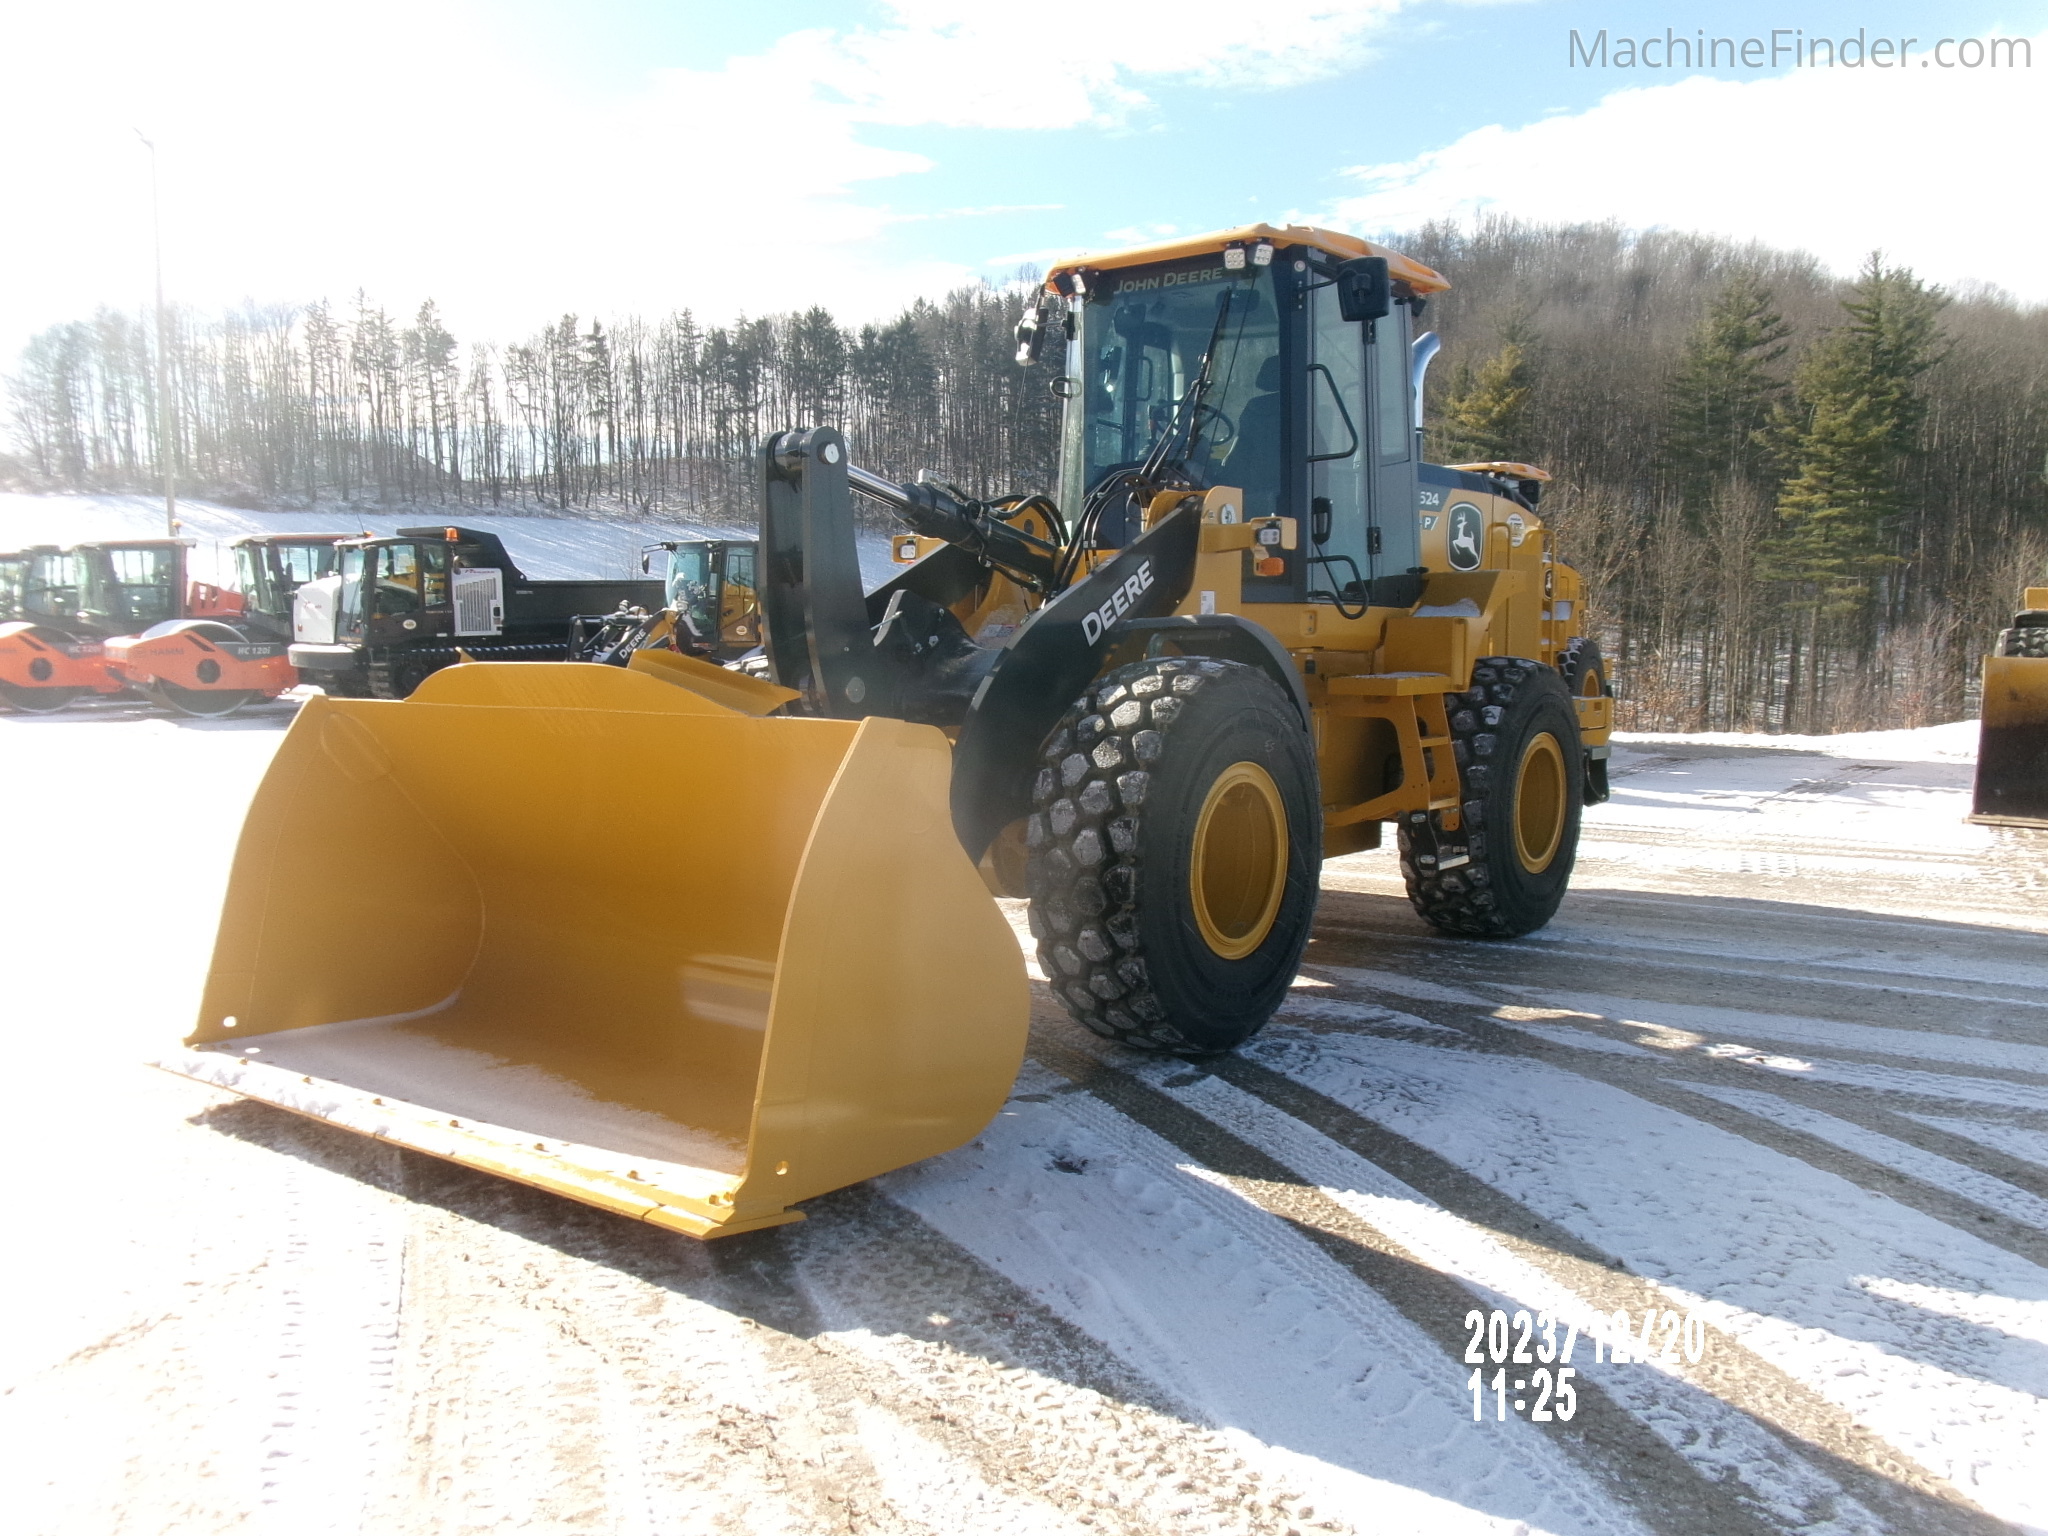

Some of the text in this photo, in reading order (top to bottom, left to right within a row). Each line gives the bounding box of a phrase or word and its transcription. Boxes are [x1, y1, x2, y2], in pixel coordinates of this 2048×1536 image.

[1113, 267, 1224, 295] JOHN DEERE
[1081, 559, 1155, 647] DEERE
[618, 628, 647, 659] DEERE
